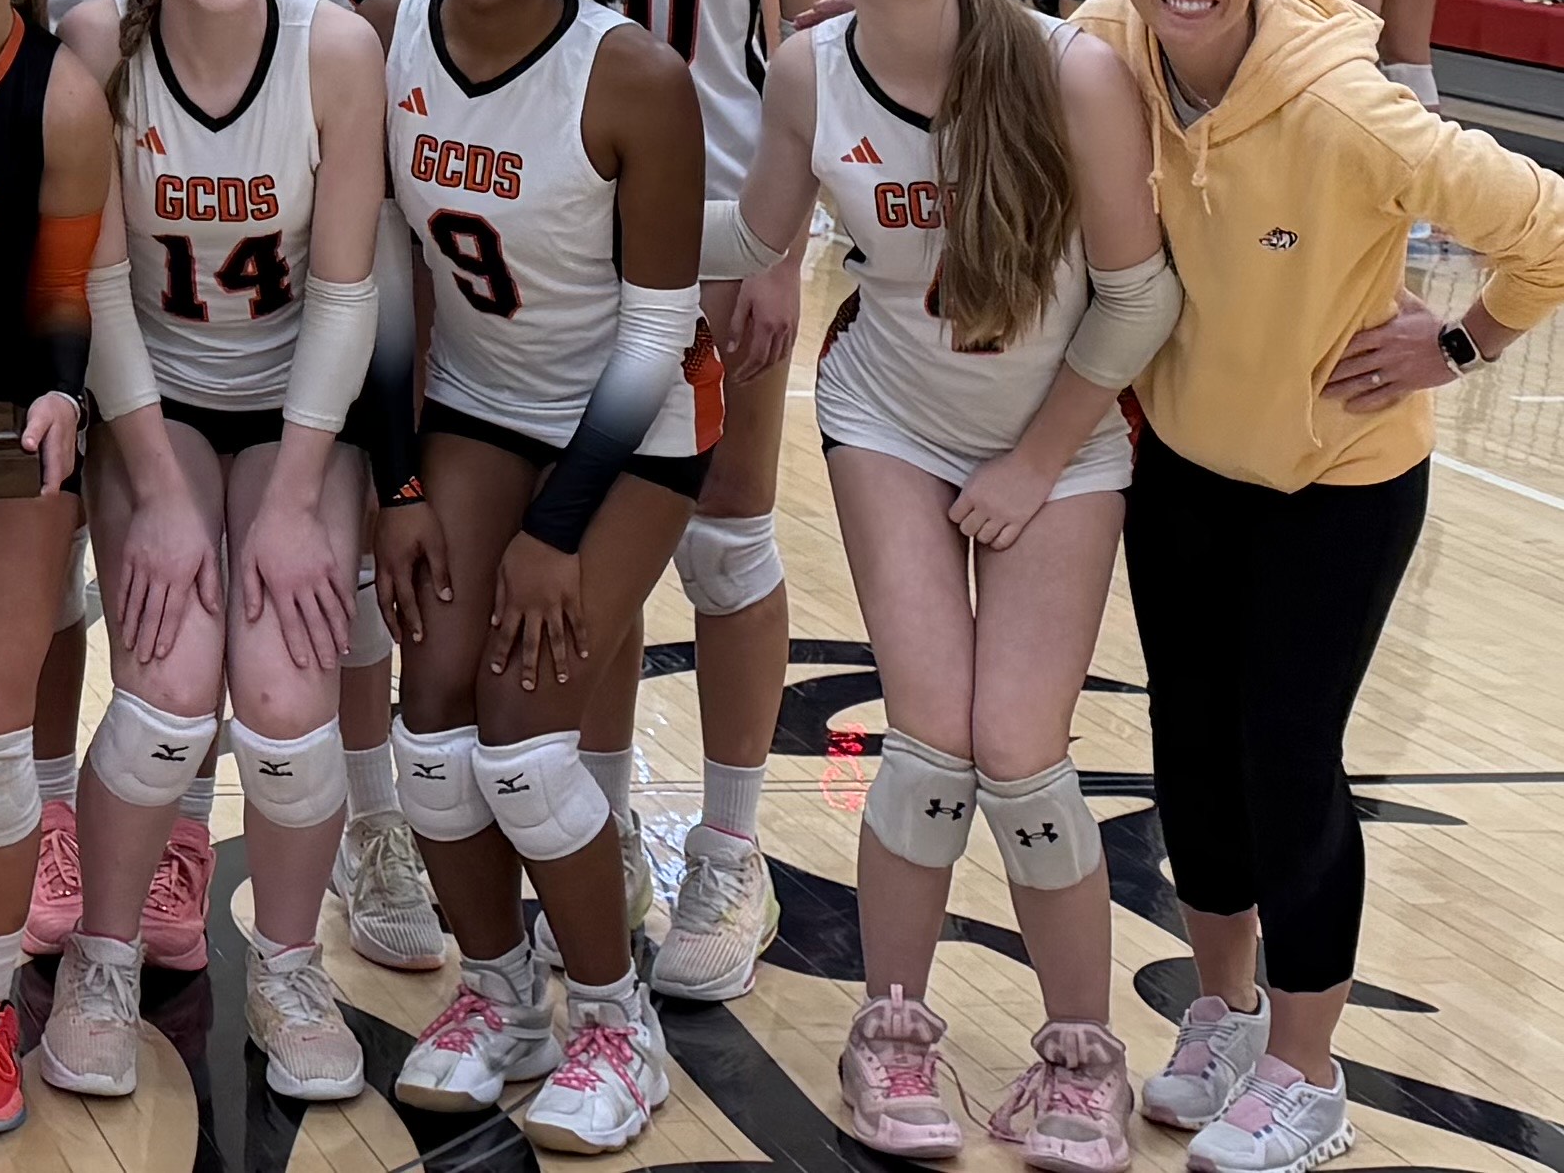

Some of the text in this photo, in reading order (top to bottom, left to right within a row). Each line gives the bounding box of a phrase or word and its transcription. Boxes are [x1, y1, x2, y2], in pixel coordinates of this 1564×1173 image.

[155, 174, 279, 222] GCDS
[411, 133, 523, 200] GCDS
[152, 229, 293, 323] 14
[427, 208, 523, 320] 9
